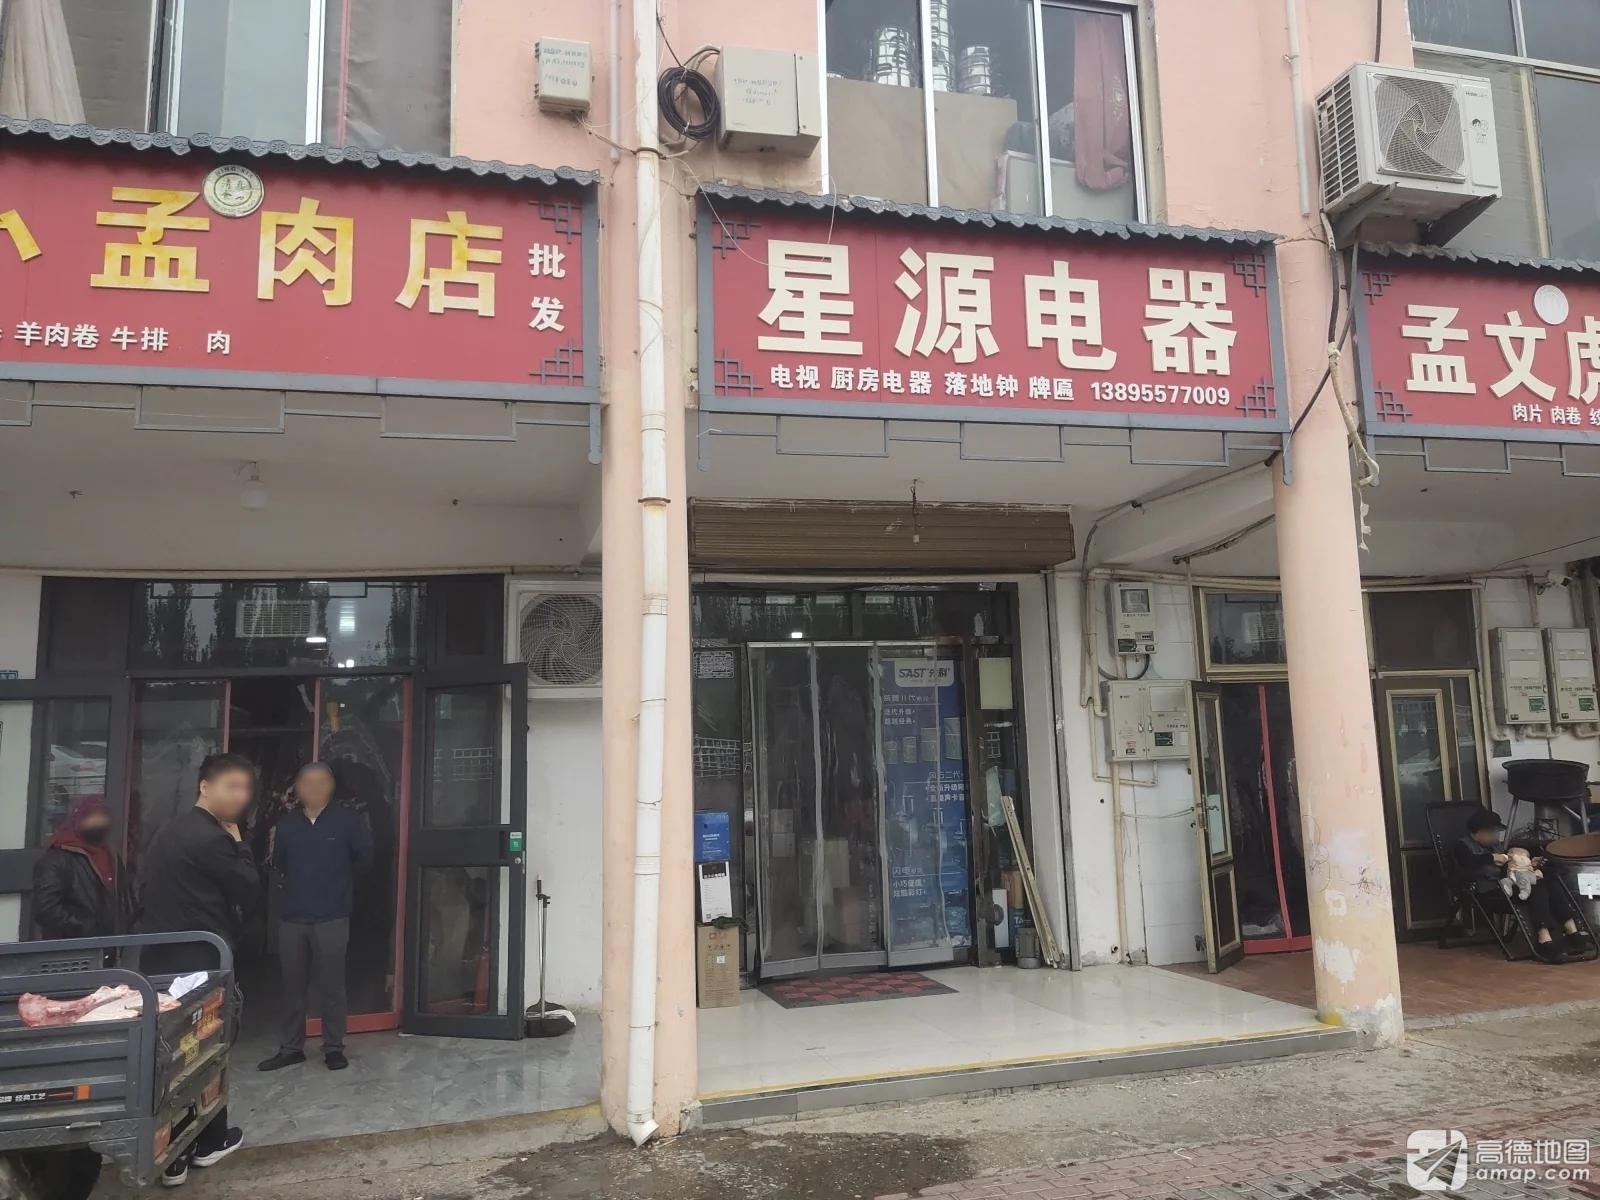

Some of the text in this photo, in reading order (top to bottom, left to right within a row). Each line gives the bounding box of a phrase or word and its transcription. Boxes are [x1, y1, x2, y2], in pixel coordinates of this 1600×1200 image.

[528, 242, 566, 332] 批发
[757, 239, 1236, 376] 星源电器
[14, 321, 99, 349] 羊肉卷
[110, 326, 168, 351] 牛排
[206, 330, 230, 354] 肉
[770, 364, 1230, 405] 电视 厨房电器 落地钟 牌匾 13895577009
[1512, 403, 1543, 422] 肉片
[1551, 406, 1581, 425] 肉卷
